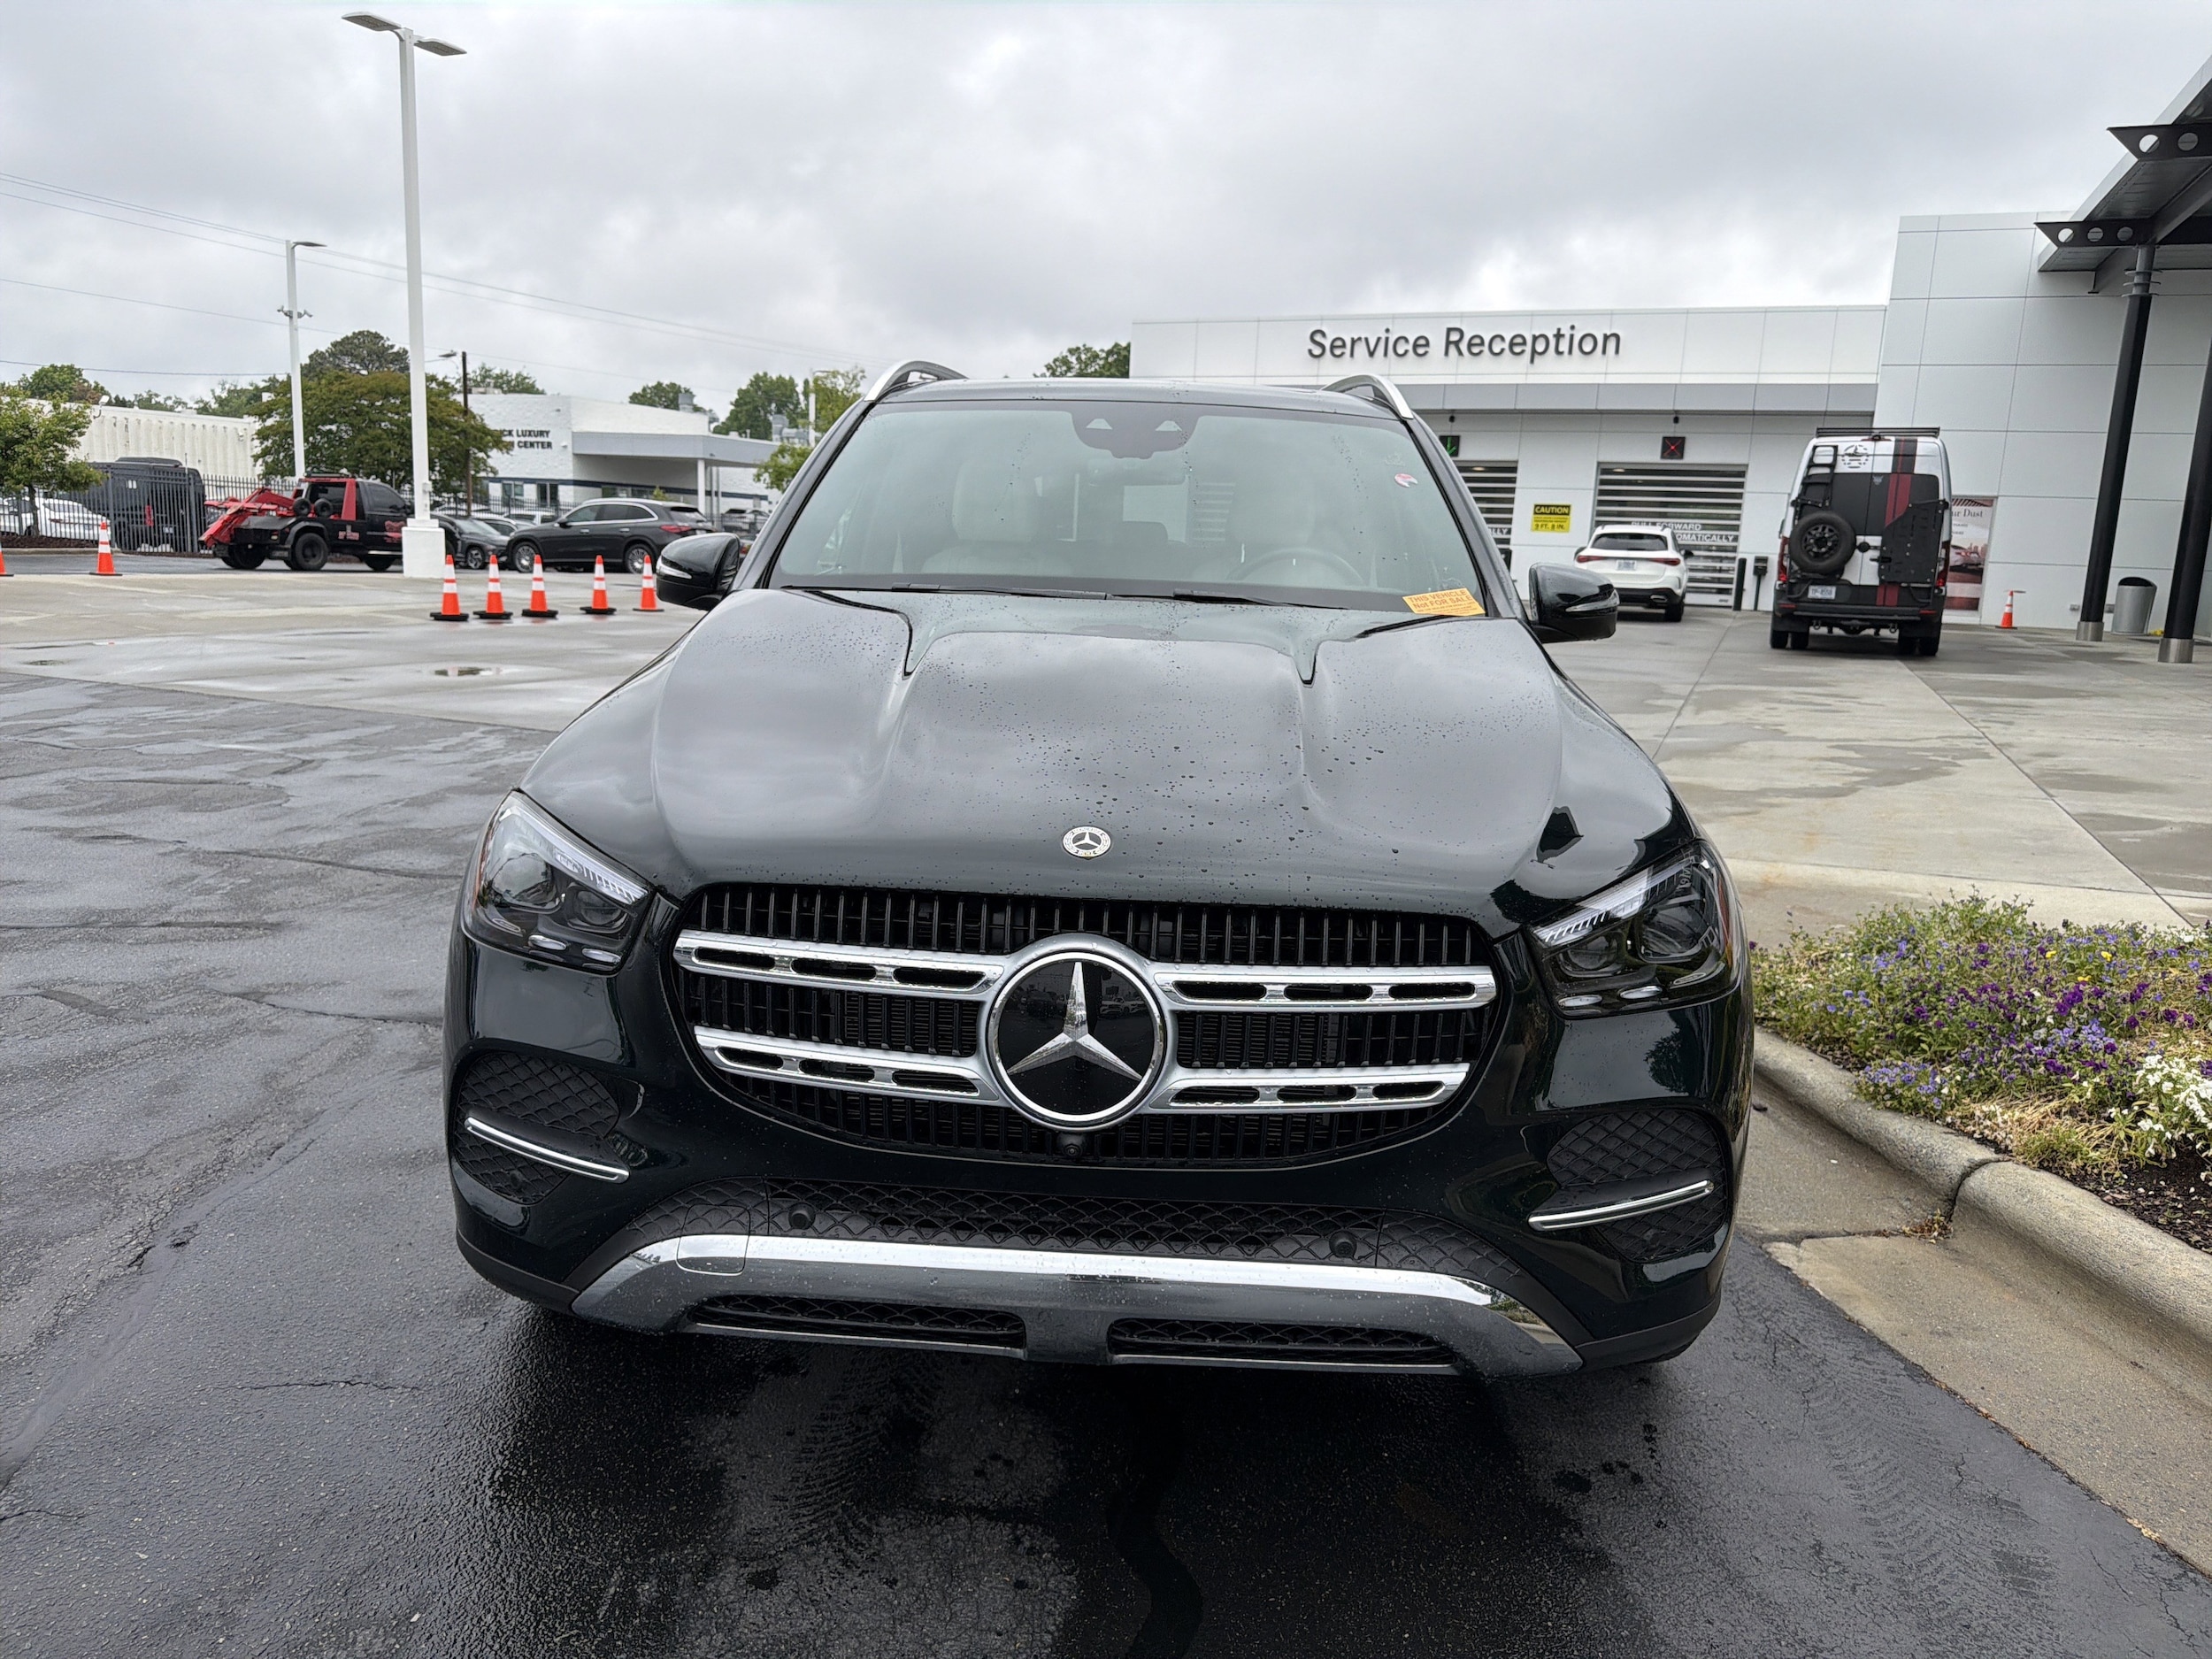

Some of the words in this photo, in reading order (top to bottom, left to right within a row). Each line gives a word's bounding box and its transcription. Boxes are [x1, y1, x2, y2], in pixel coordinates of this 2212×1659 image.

[1308, 327, 1431, 359] Service
[1443, 325, 1622, 365] Reception
[1963, 508, 1983, 518] Dust
[1675, 533, 1734, 542] OMATICALLY
